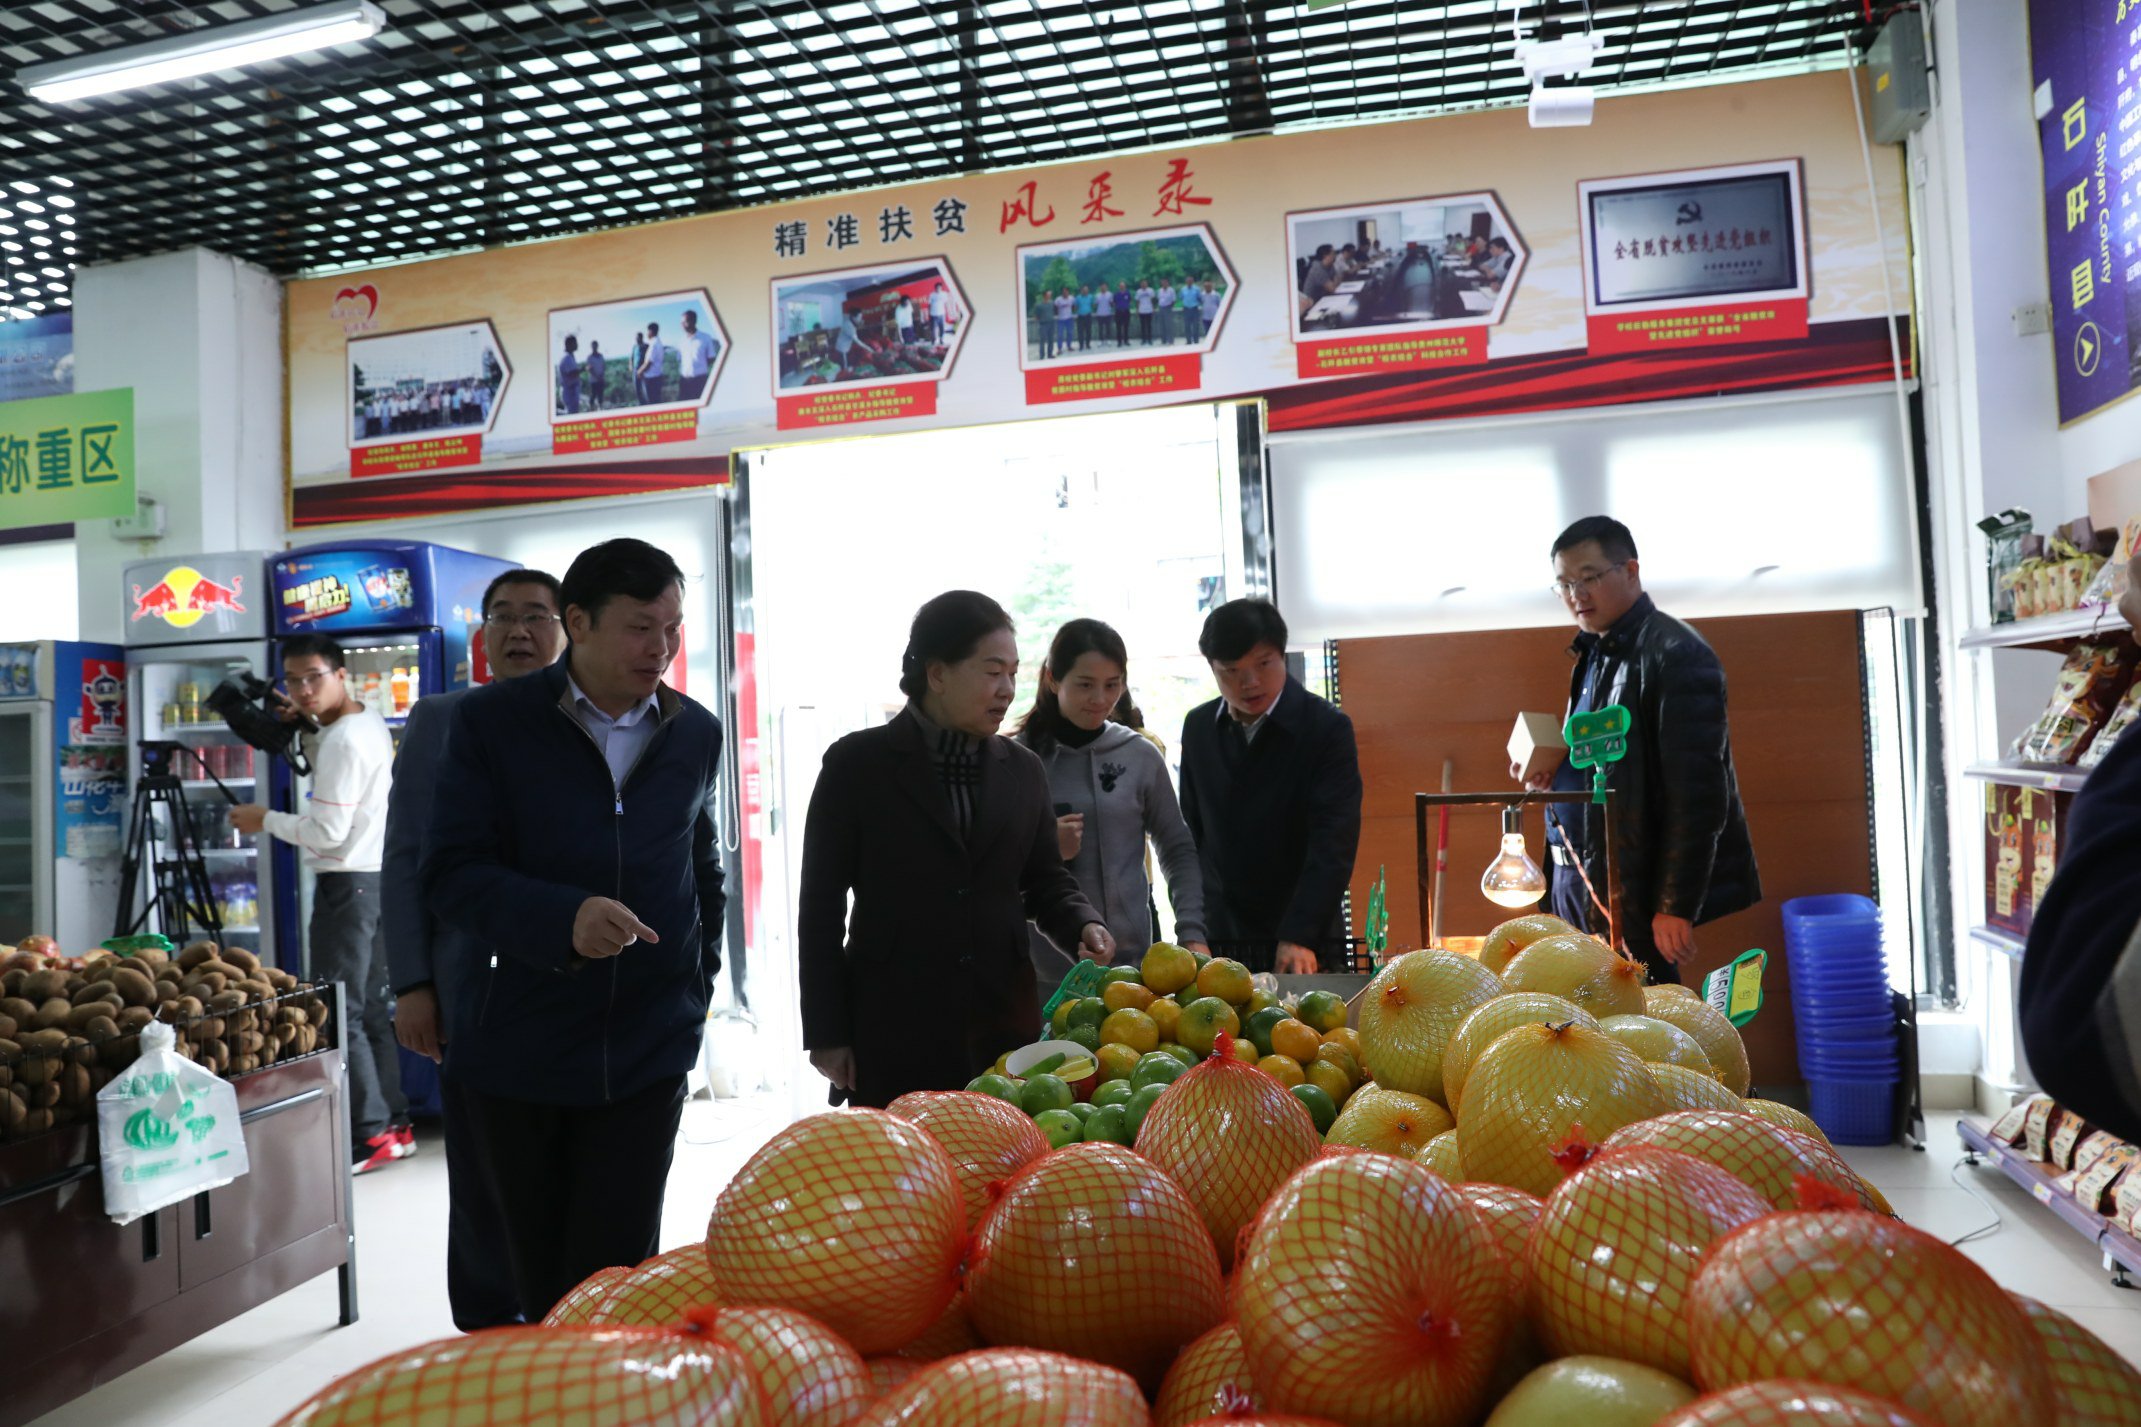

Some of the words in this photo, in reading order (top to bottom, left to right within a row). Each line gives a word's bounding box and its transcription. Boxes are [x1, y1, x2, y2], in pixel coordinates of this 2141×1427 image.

[774, 199, 967, 258] 精准扶贫
[1000, 158, 1213, 234] 风采录
[2062, 96, 2095, 310] 石阡县
[2098, 208, 2112, 284] County
[0, 423, 119, 494] 称重区
